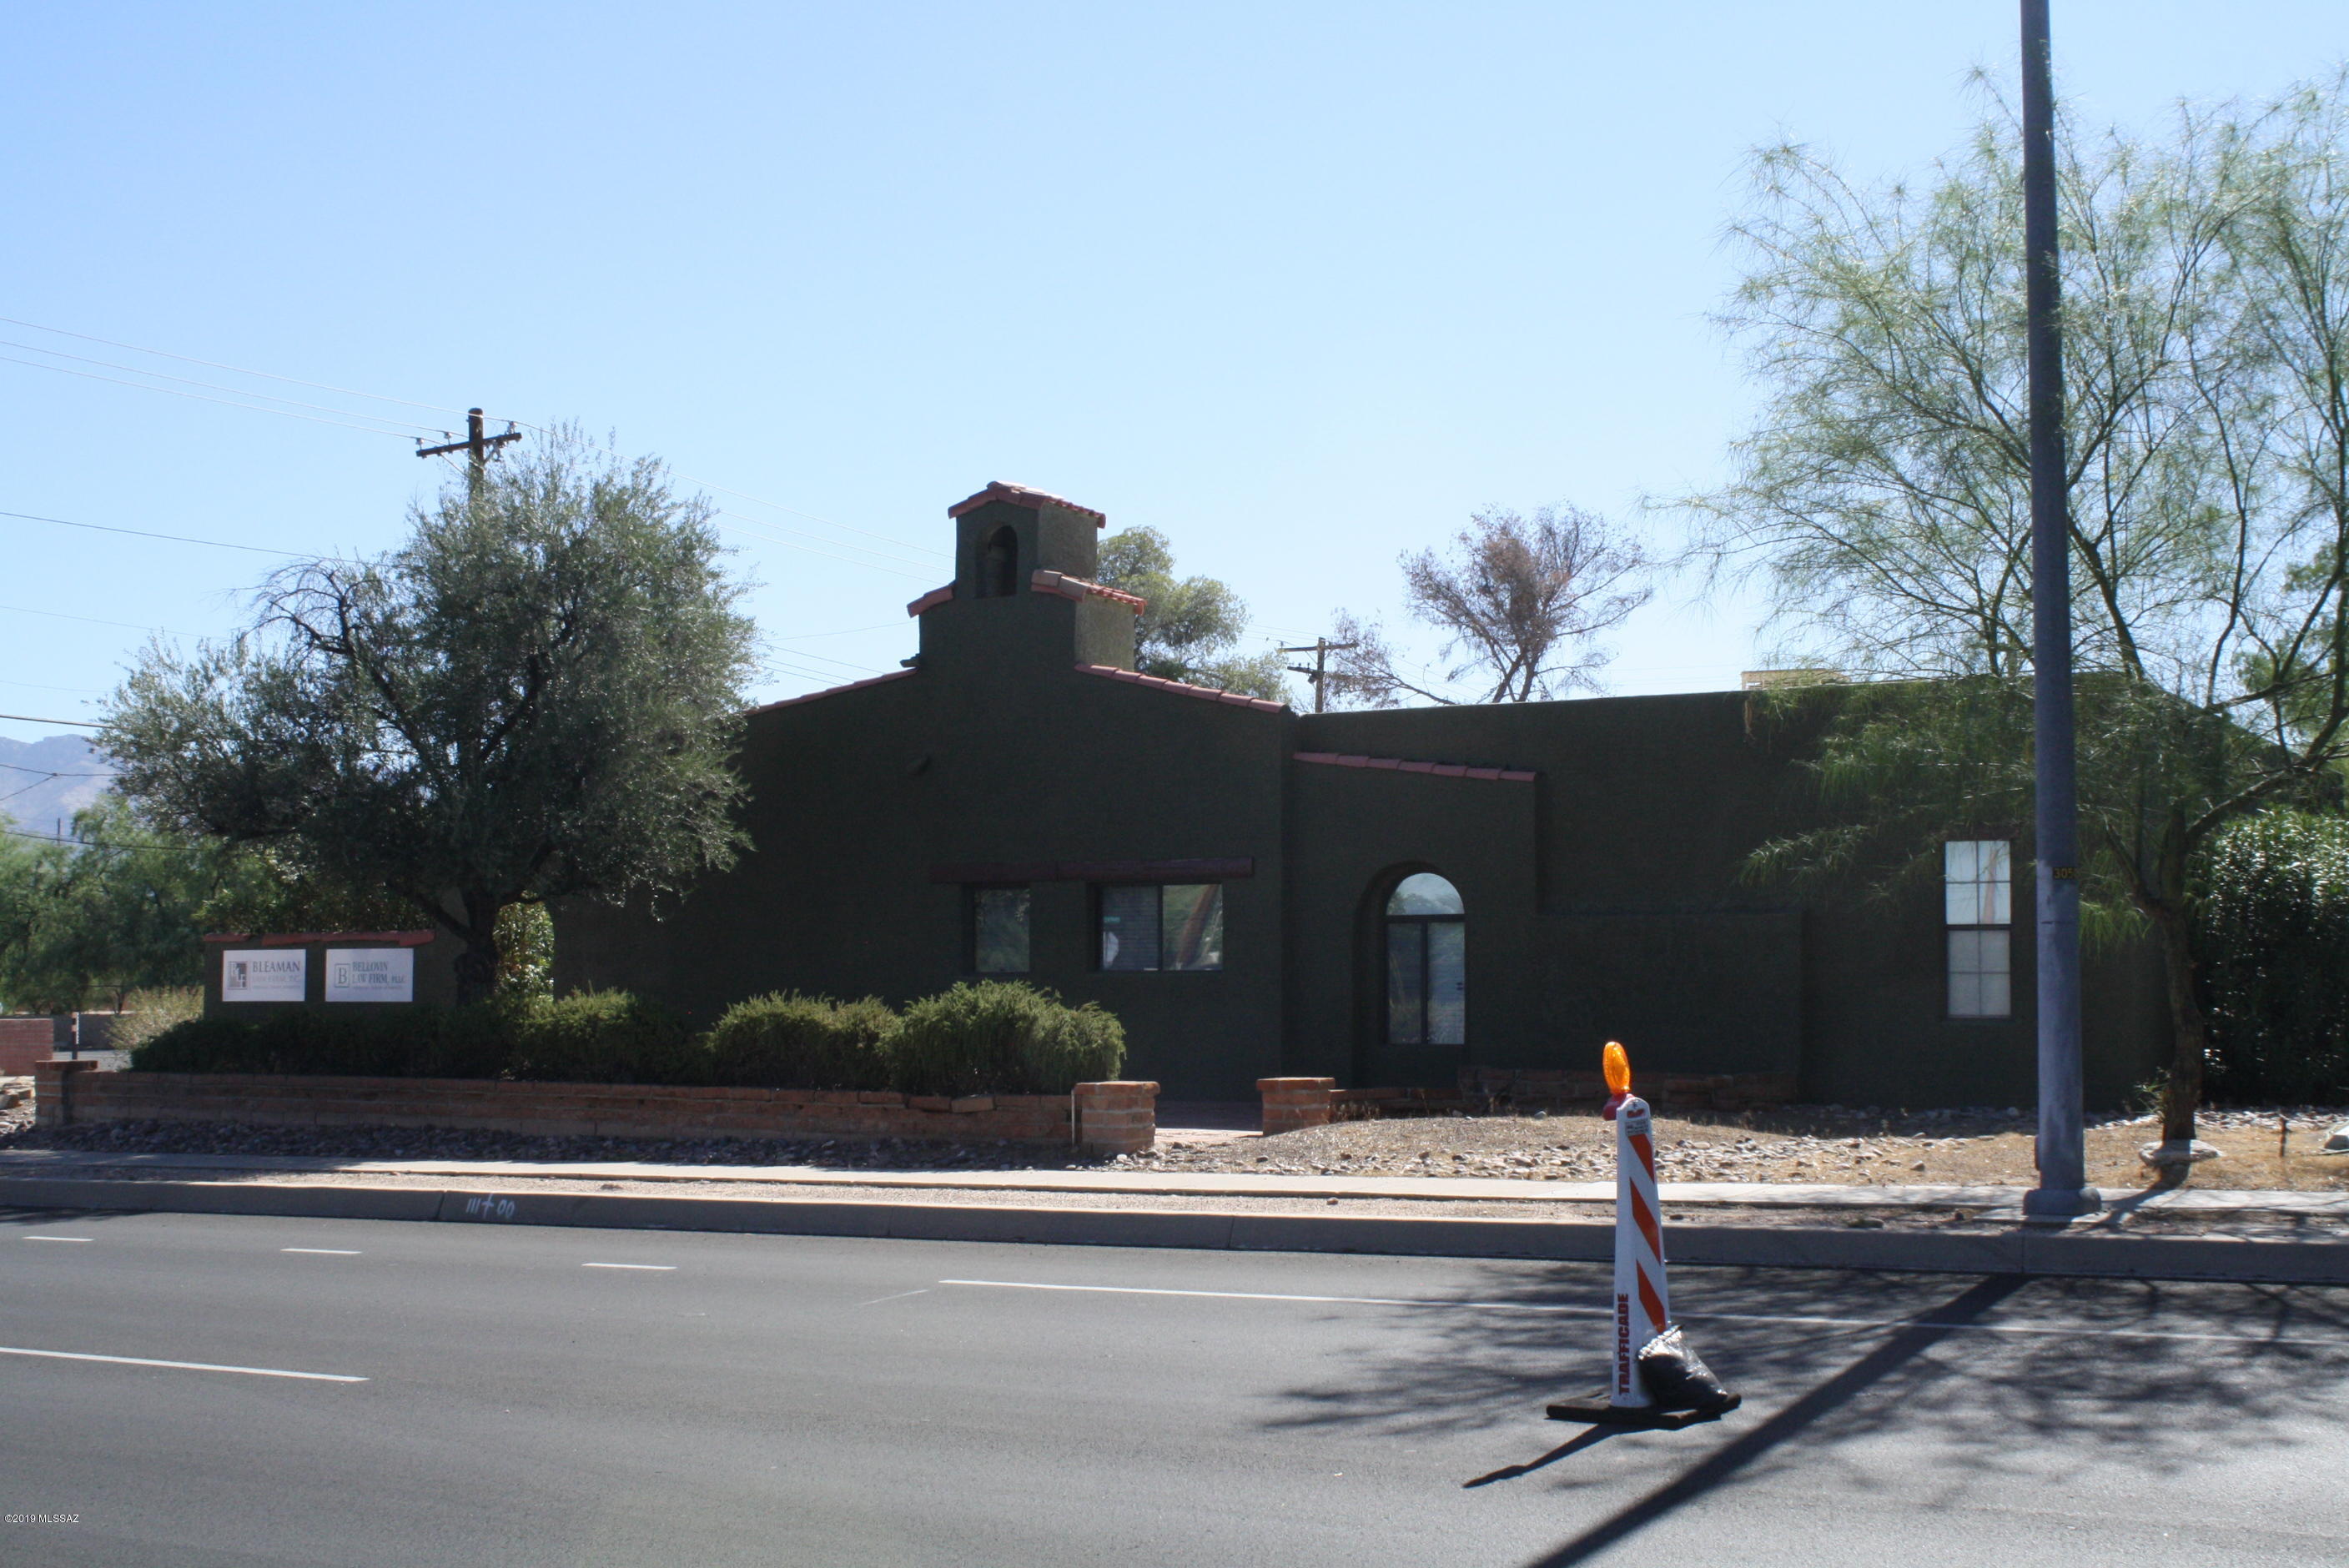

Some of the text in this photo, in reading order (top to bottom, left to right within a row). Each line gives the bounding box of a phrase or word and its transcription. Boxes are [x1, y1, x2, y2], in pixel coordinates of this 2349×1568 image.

[253, 961, 300, 972] BLEAMAN
[339, 967, 347, 984] B
[1617, 1294, 1630, 1395] TRAFFICADE
